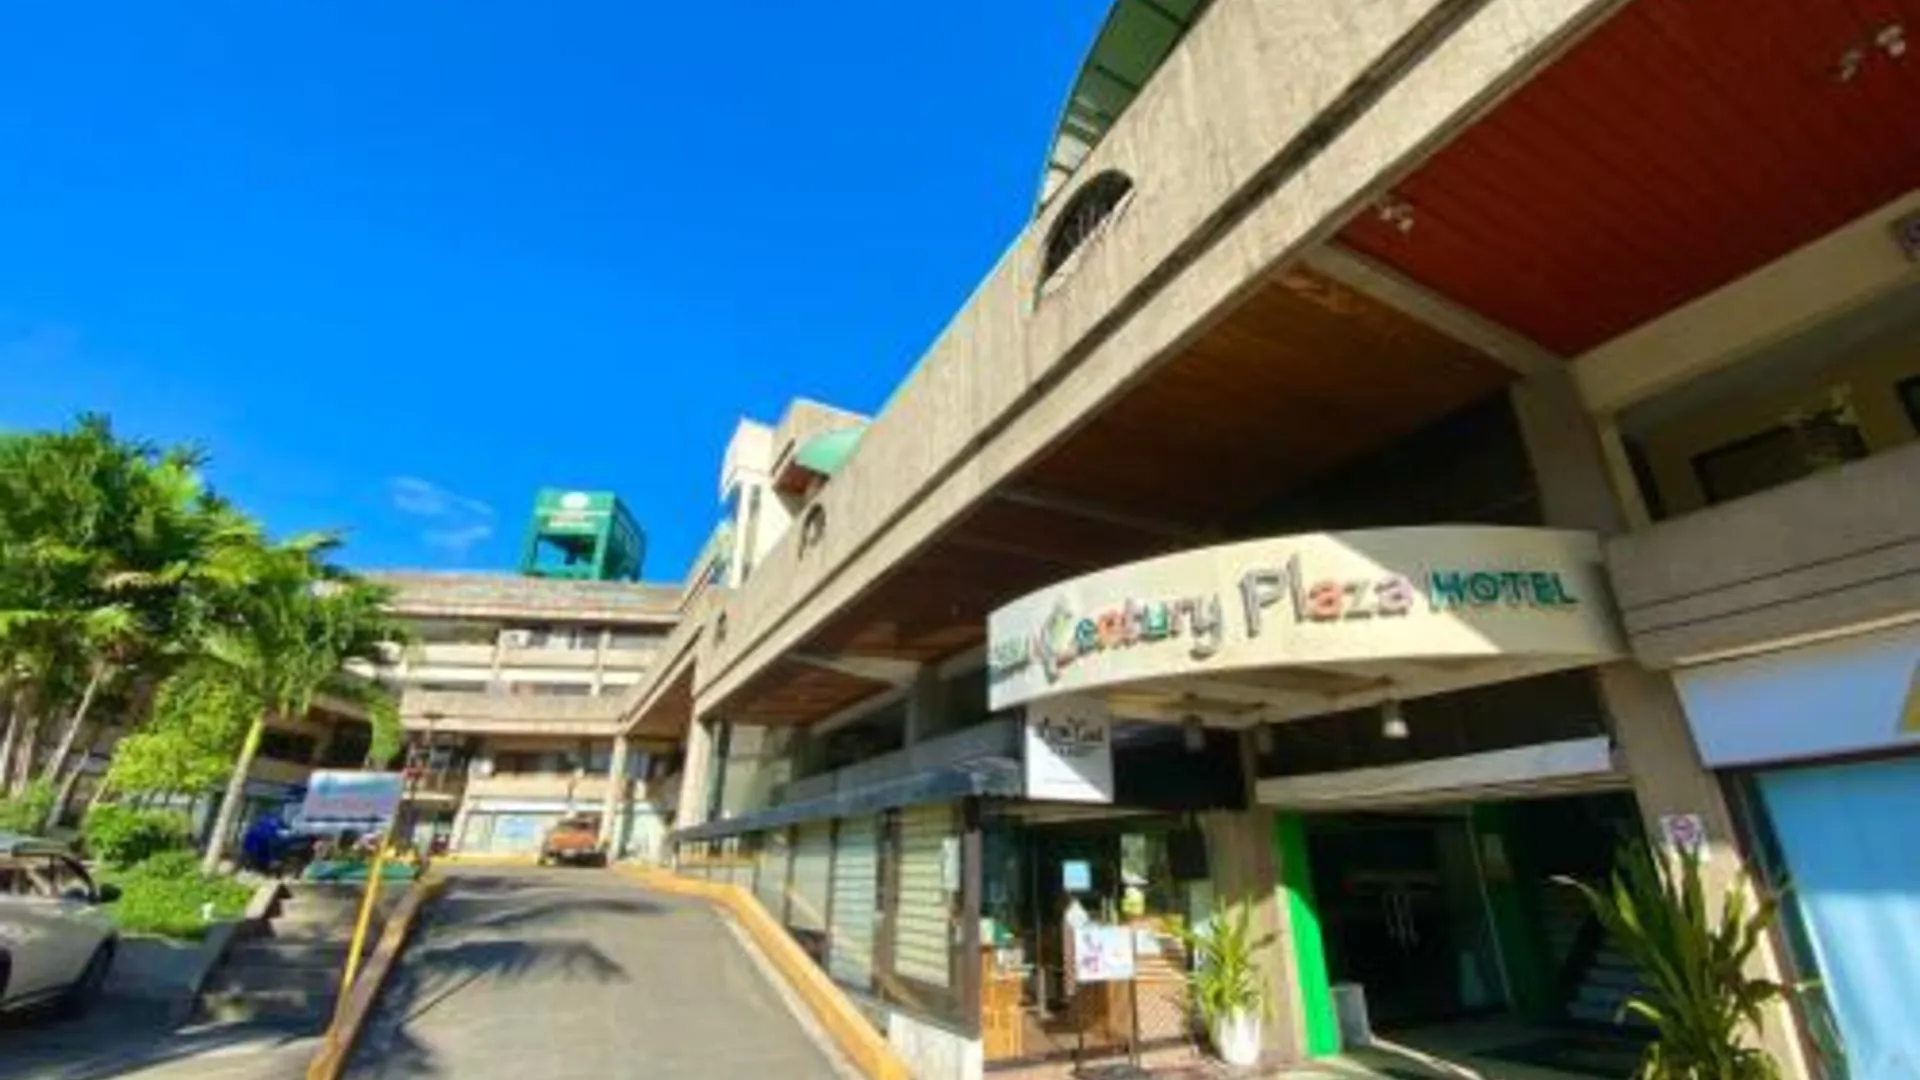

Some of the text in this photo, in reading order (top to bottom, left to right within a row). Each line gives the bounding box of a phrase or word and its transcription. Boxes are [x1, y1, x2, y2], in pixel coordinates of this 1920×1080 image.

[1032, 596, 1222, 684] Century
[1239, 552, 1414, 638] Plaza
[1428, 569, 1579, 613] HOTEL
